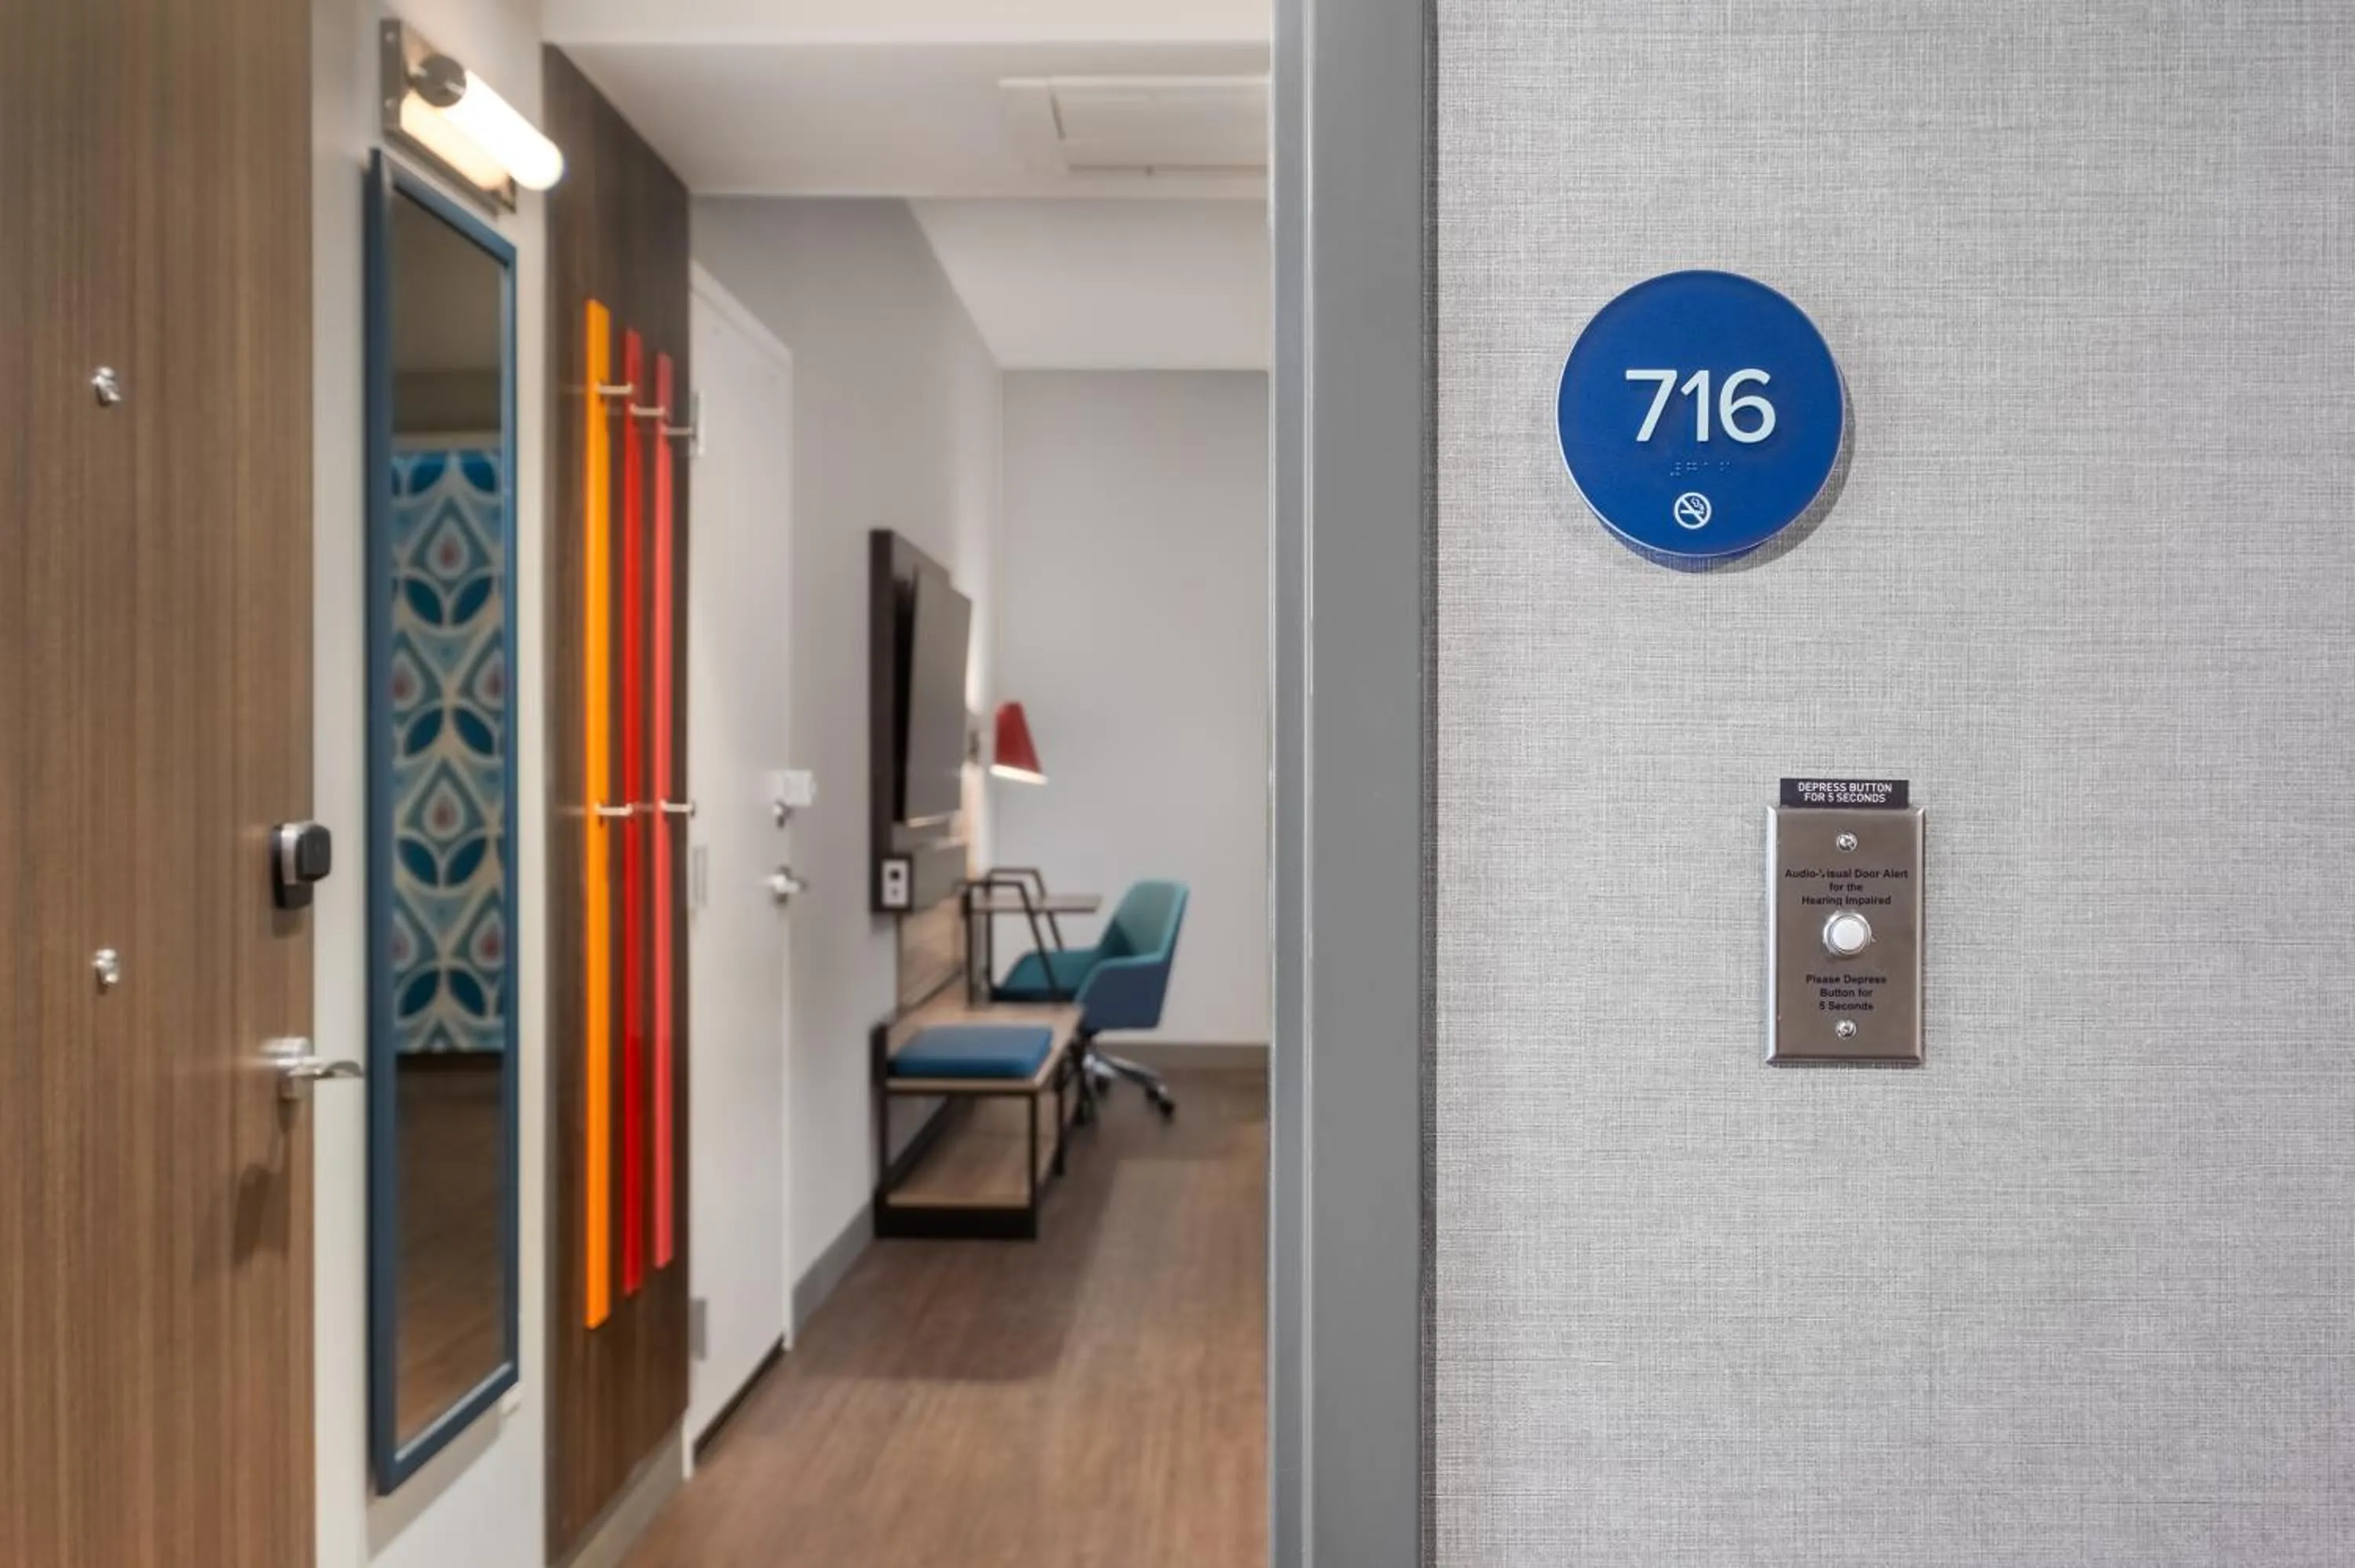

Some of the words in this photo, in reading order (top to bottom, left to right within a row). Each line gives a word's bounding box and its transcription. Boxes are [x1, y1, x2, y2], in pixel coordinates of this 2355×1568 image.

[1625, 368, 1776, 443] 716
[1798, 782, 1846, 792] DEPRESS
[1849, 782, 1893, 793] BUTTON
[1804, 793, 1825, 801] FOR
[1827, 793, 1835, 802] 5
[1836, 793, 1886, 803] SECONDS
[1855, 869, 1879, 878] Door
[1882, 869, 1909, 878] Alert
[1829, 882, 1843, 892] for
[1846, 882, 1863, 892] the
[1802, 896, 1842, 906] Hearing
[1846, 896, 1891, 906] Impaired
[1806, 974, 1840, 983] Please
[1843, 974, 1887, 985] Depress
[1820, 988, 1855, 997] Button
[1858, 988, 1873, 997] for
[1819, 1001, 1825, 1010] 5
[1828, 1001, 1874, 1010] Seconds
